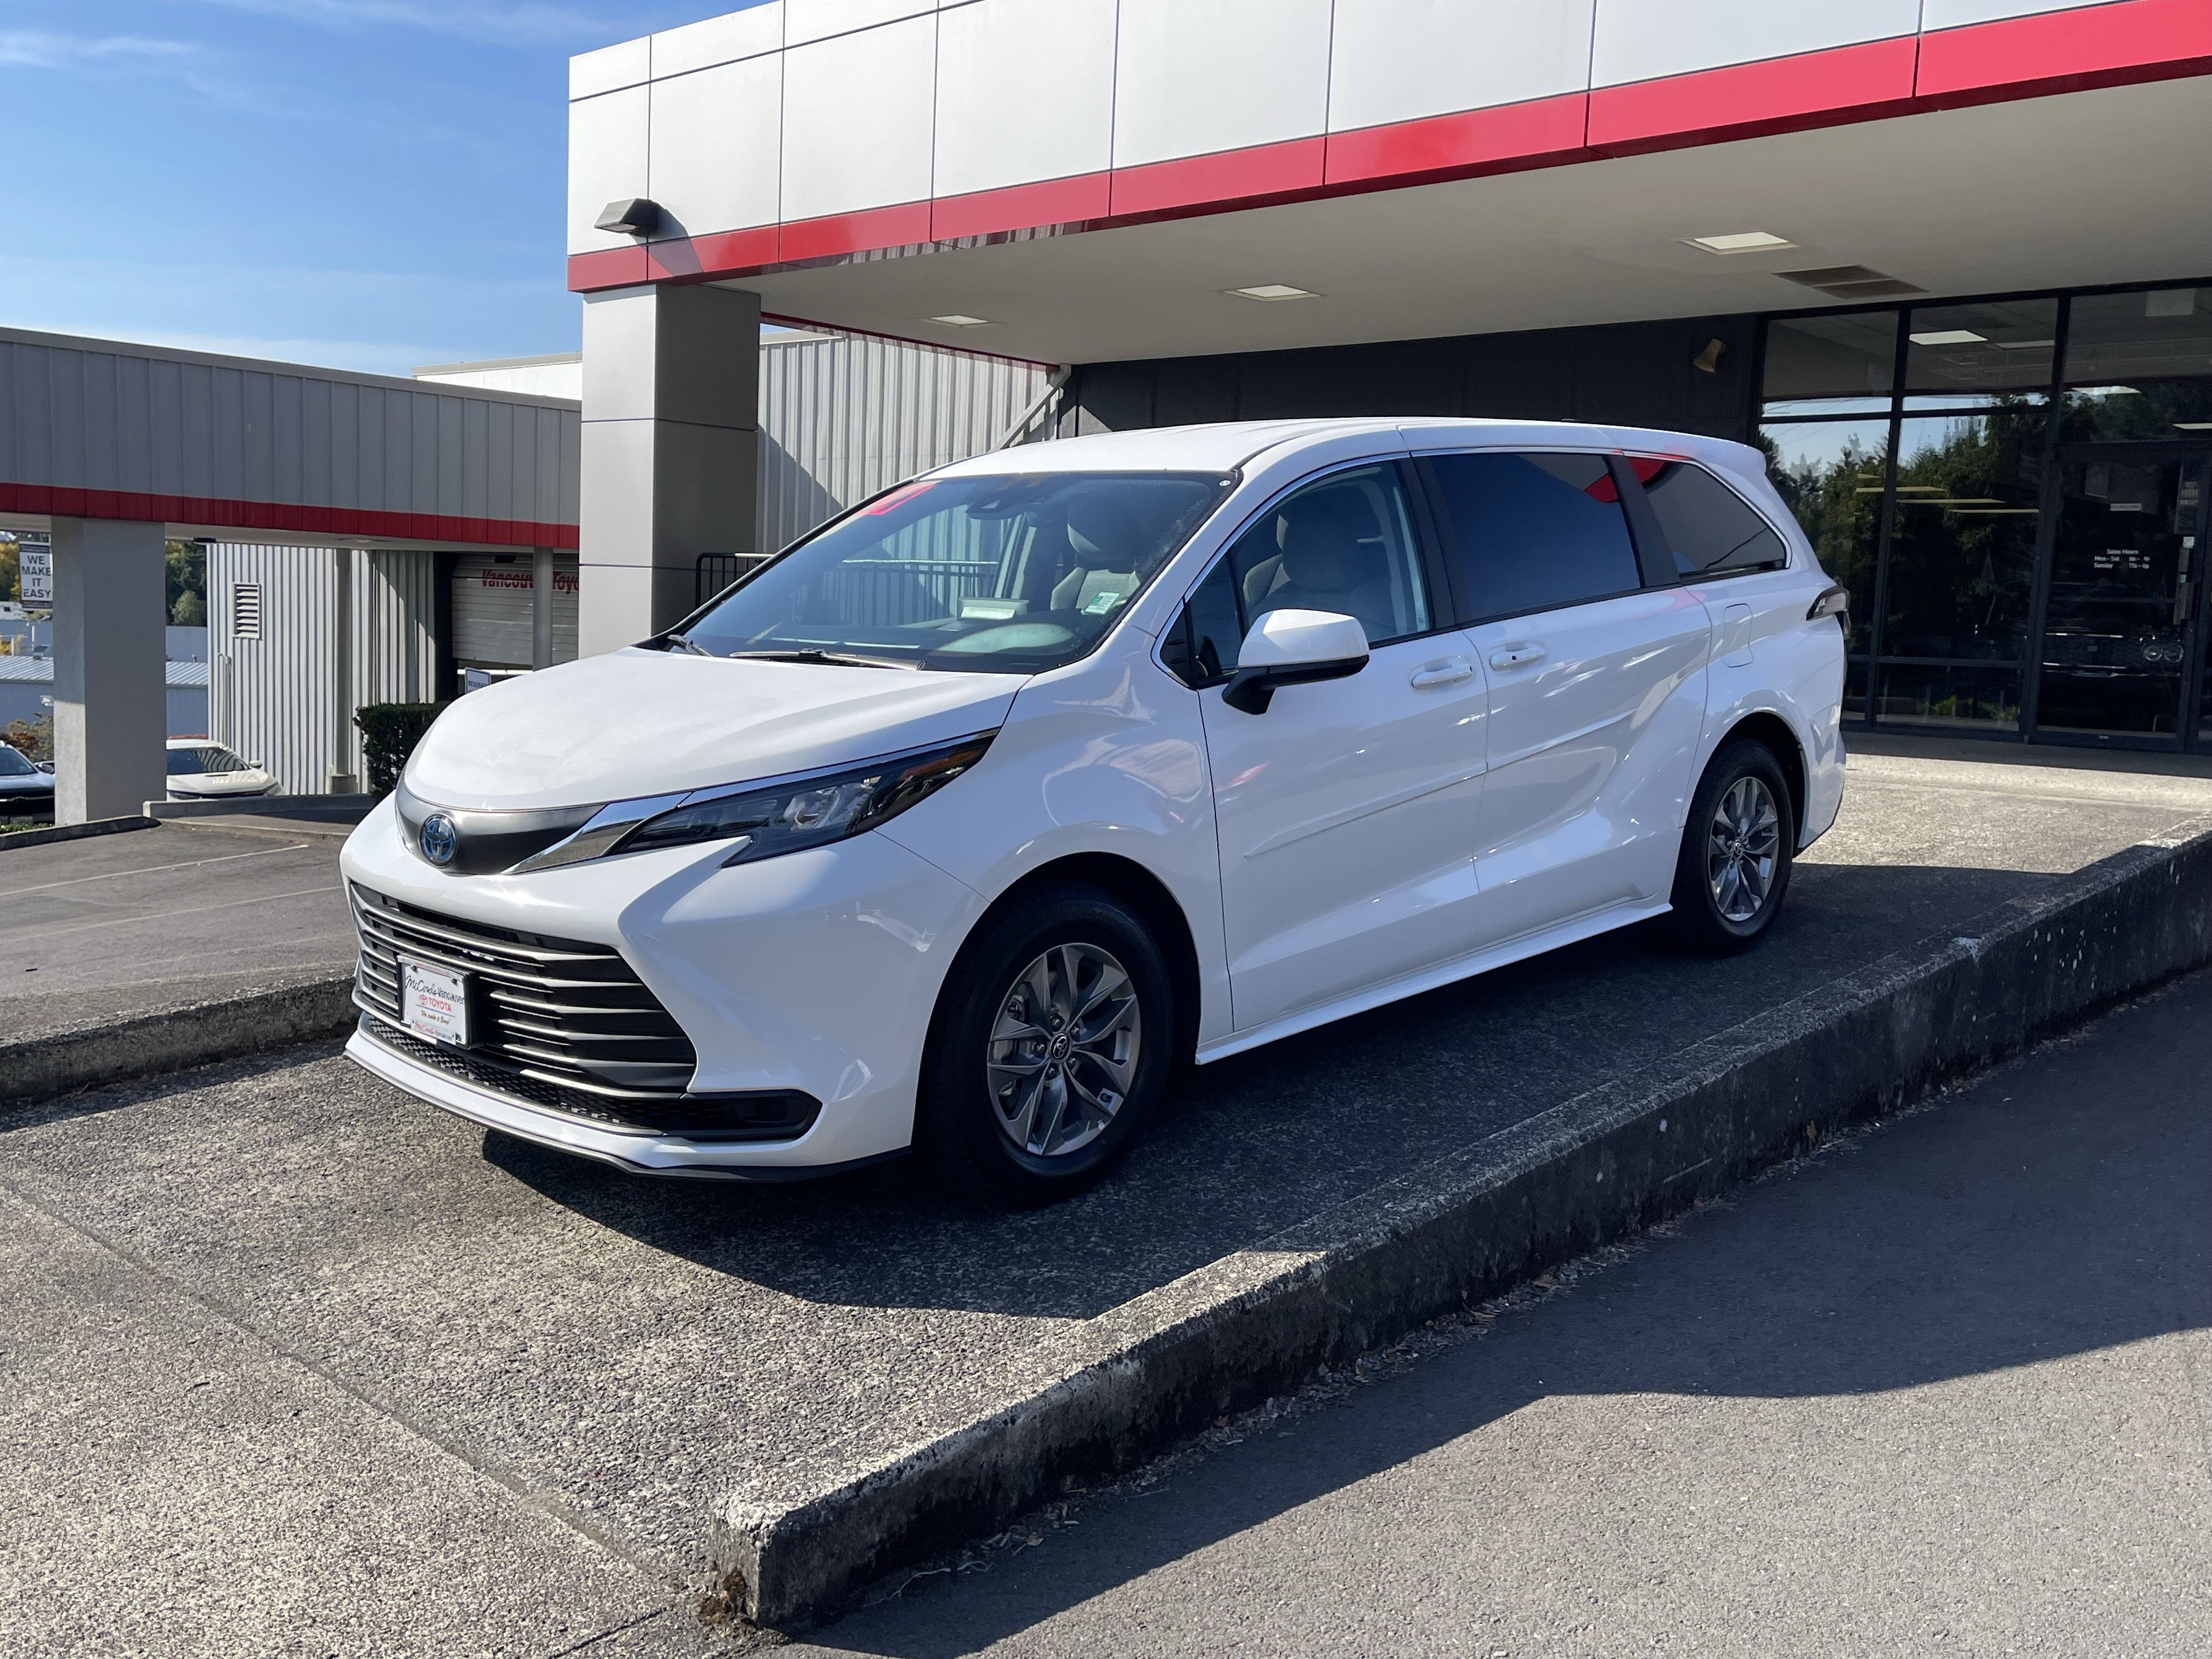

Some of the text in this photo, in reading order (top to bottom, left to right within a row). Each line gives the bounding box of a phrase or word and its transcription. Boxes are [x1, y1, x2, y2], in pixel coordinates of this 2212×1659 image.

[27, 555, 45, 565] WE
[21, 566, 51, 577] MAKE
[32, 578, 42, 587] IT
[23, 589, 51, 599] EASY
[428, 997, 452, 1013] TOYOTA
